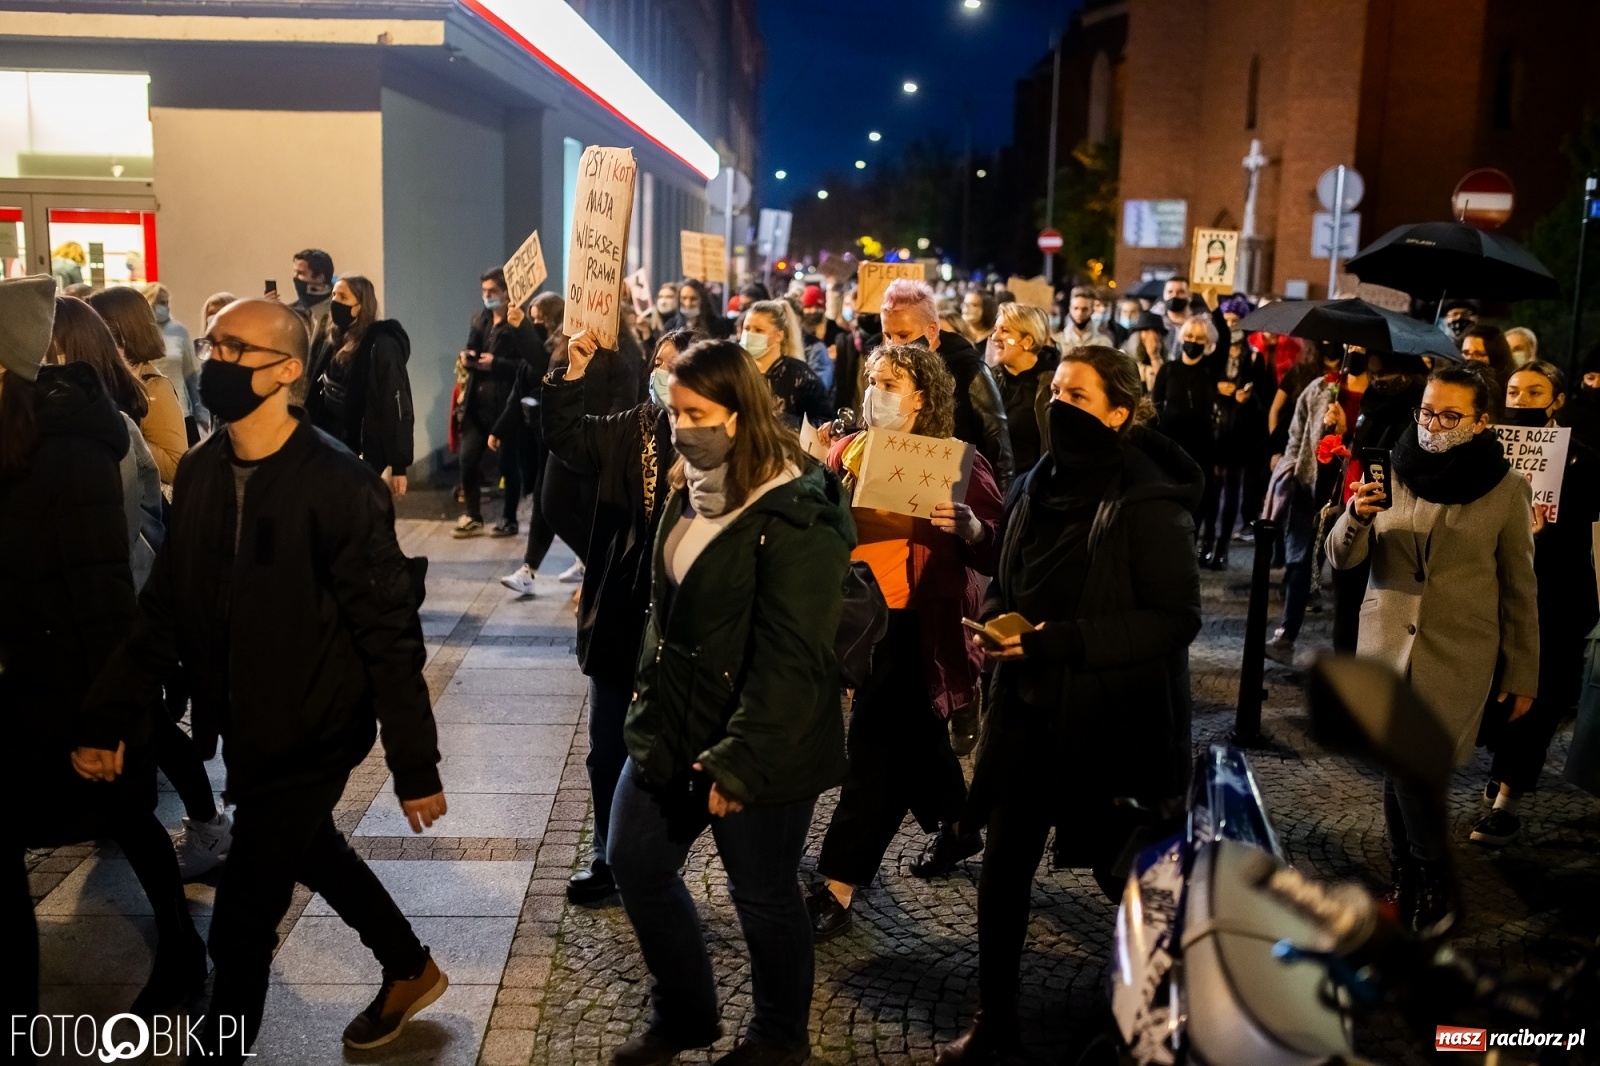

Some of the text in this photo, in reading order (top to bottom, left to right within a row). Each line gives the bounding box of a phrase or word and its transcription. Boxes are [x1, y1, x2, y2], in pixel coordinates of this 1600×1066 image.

[585, 149, 607, 179] PSY
[586, 256, 616, 285] PRAWA
[570, 283, 613, 317] OD NAS
[1496, 428, 1558, 443] RZE RÓŻE
